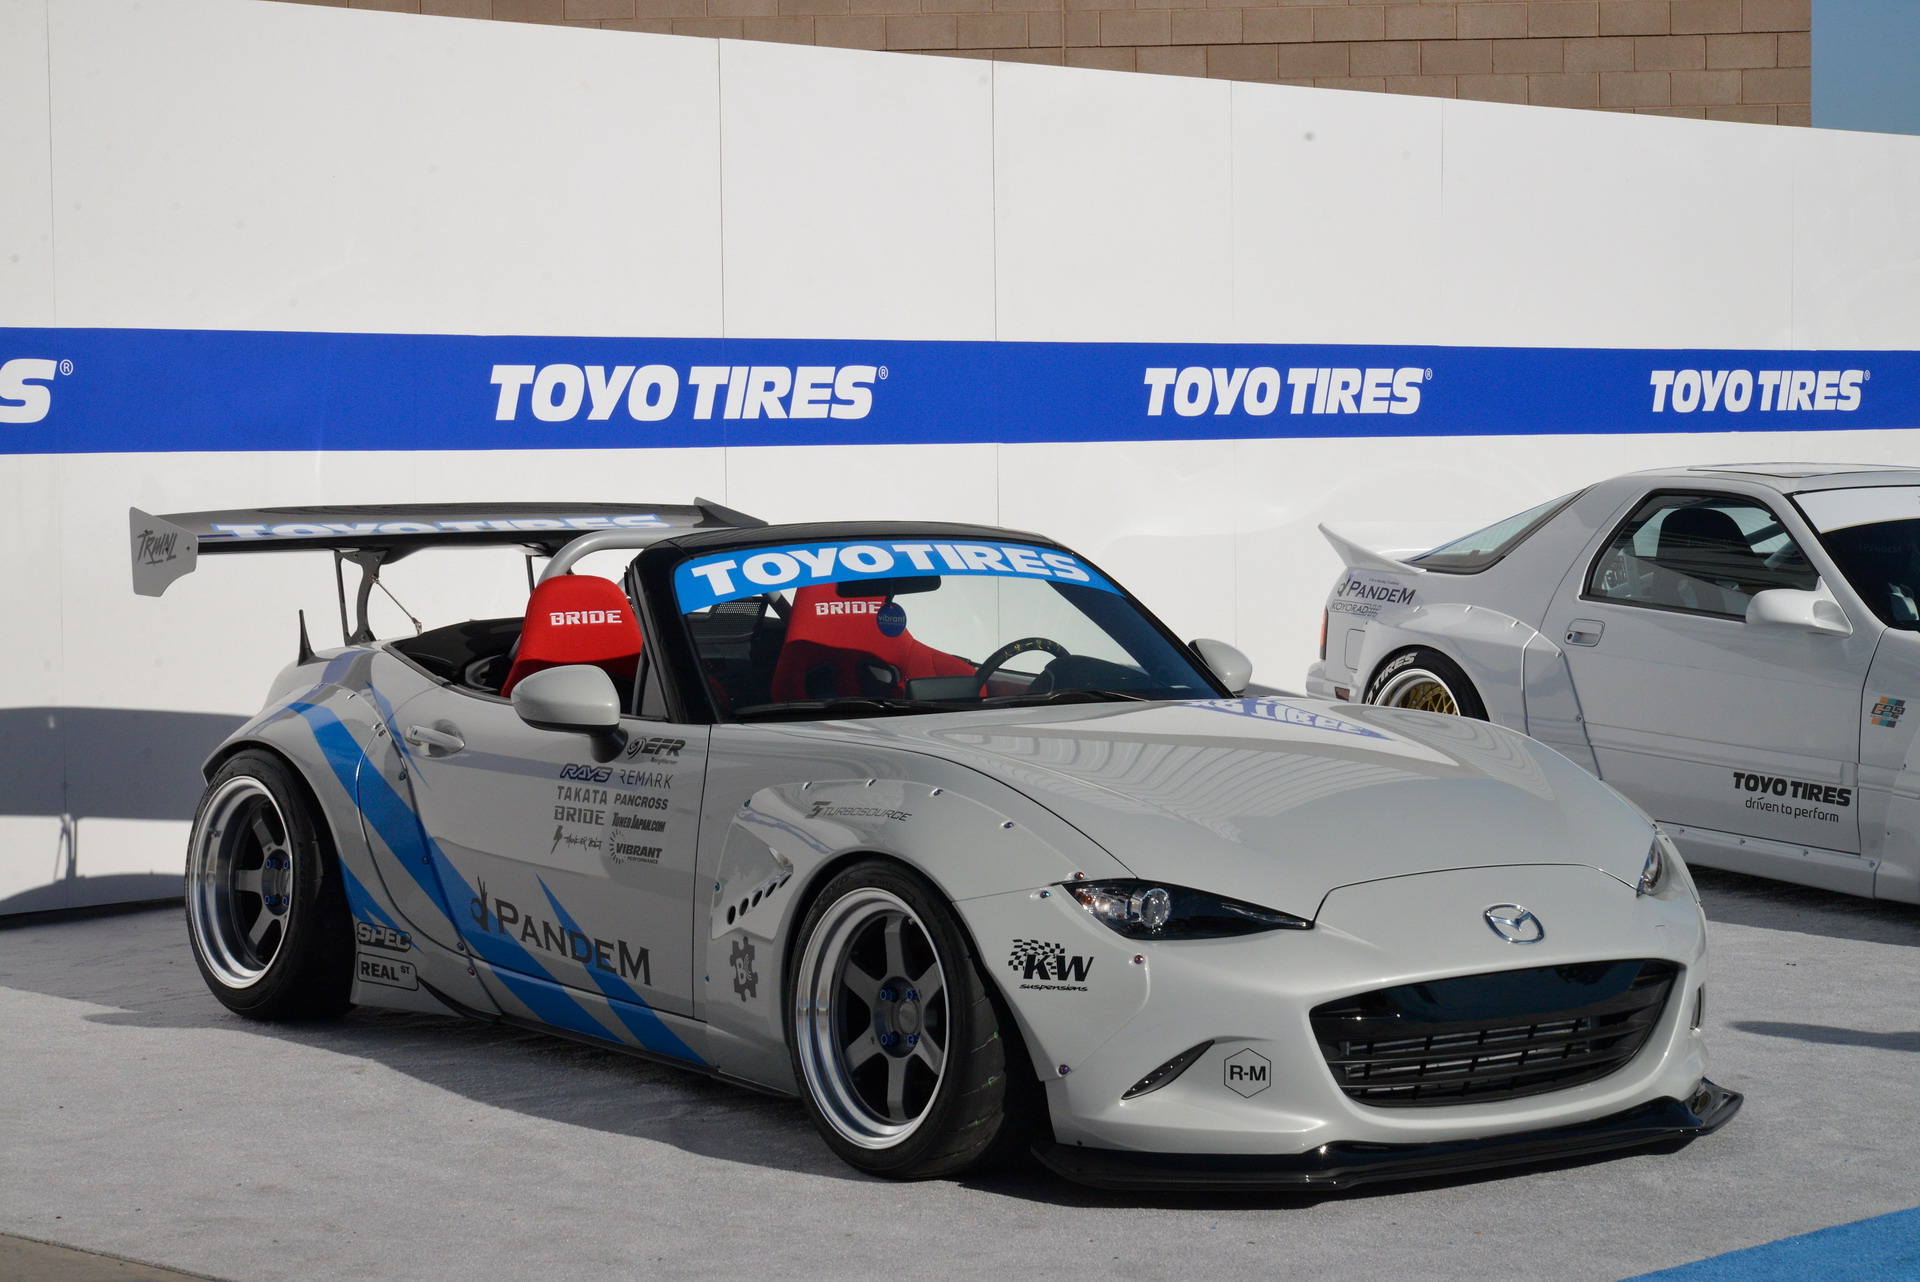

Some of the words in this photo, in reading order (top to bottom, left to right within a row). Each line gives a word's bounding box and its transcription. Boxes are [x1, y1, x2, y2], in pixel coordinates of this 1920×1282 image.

[490, 364, 679, 422] TOYO
[1144, 366, 1281, 417] TOYO
[1650, 369, 1754, 413] TOYO
[691, 546, 894, 597] TOYO
[903, 544, 1091, 583] TIRES
[1346, 581, 1417, 605] PANDEM
[549, 610, 623, 626] BRIDE
[815, 601, 882, 616] BRIDE
[1331, 602, 1368, 614] KOYORAD
[1366, 652, 1418, 690] TIRES
[641, 737, 686, 757] EFR
[560, 763, 613, 783] RAYS
[620, 769, 674, 789] REMARK
[557, 785, 608, 805] TAKATA
[1733, 771, 1788, 796] TOYO
[1790, 780, 1852, 807] TIRES
[614, 793, 668, 810] PANCROSS
[554, 805, 605, 826] BRIDE
[824, 806, 912, 822] TURBOSOURCE
[1781, 803, 1792, 815] to
[1794, 807, 1839, 823] perform
[616, 842, 662, 858] VIBRANT
[357, 921, 412, 952] SPEC
[495, 898, 652, 987] PANDEM
[360, 961, 400, 982] REAL
[1023, 955, 1094, 982] KW
[1019, 983, 1088, 992] suspensions
[1229, 1065, 1267, 1082] R-M
